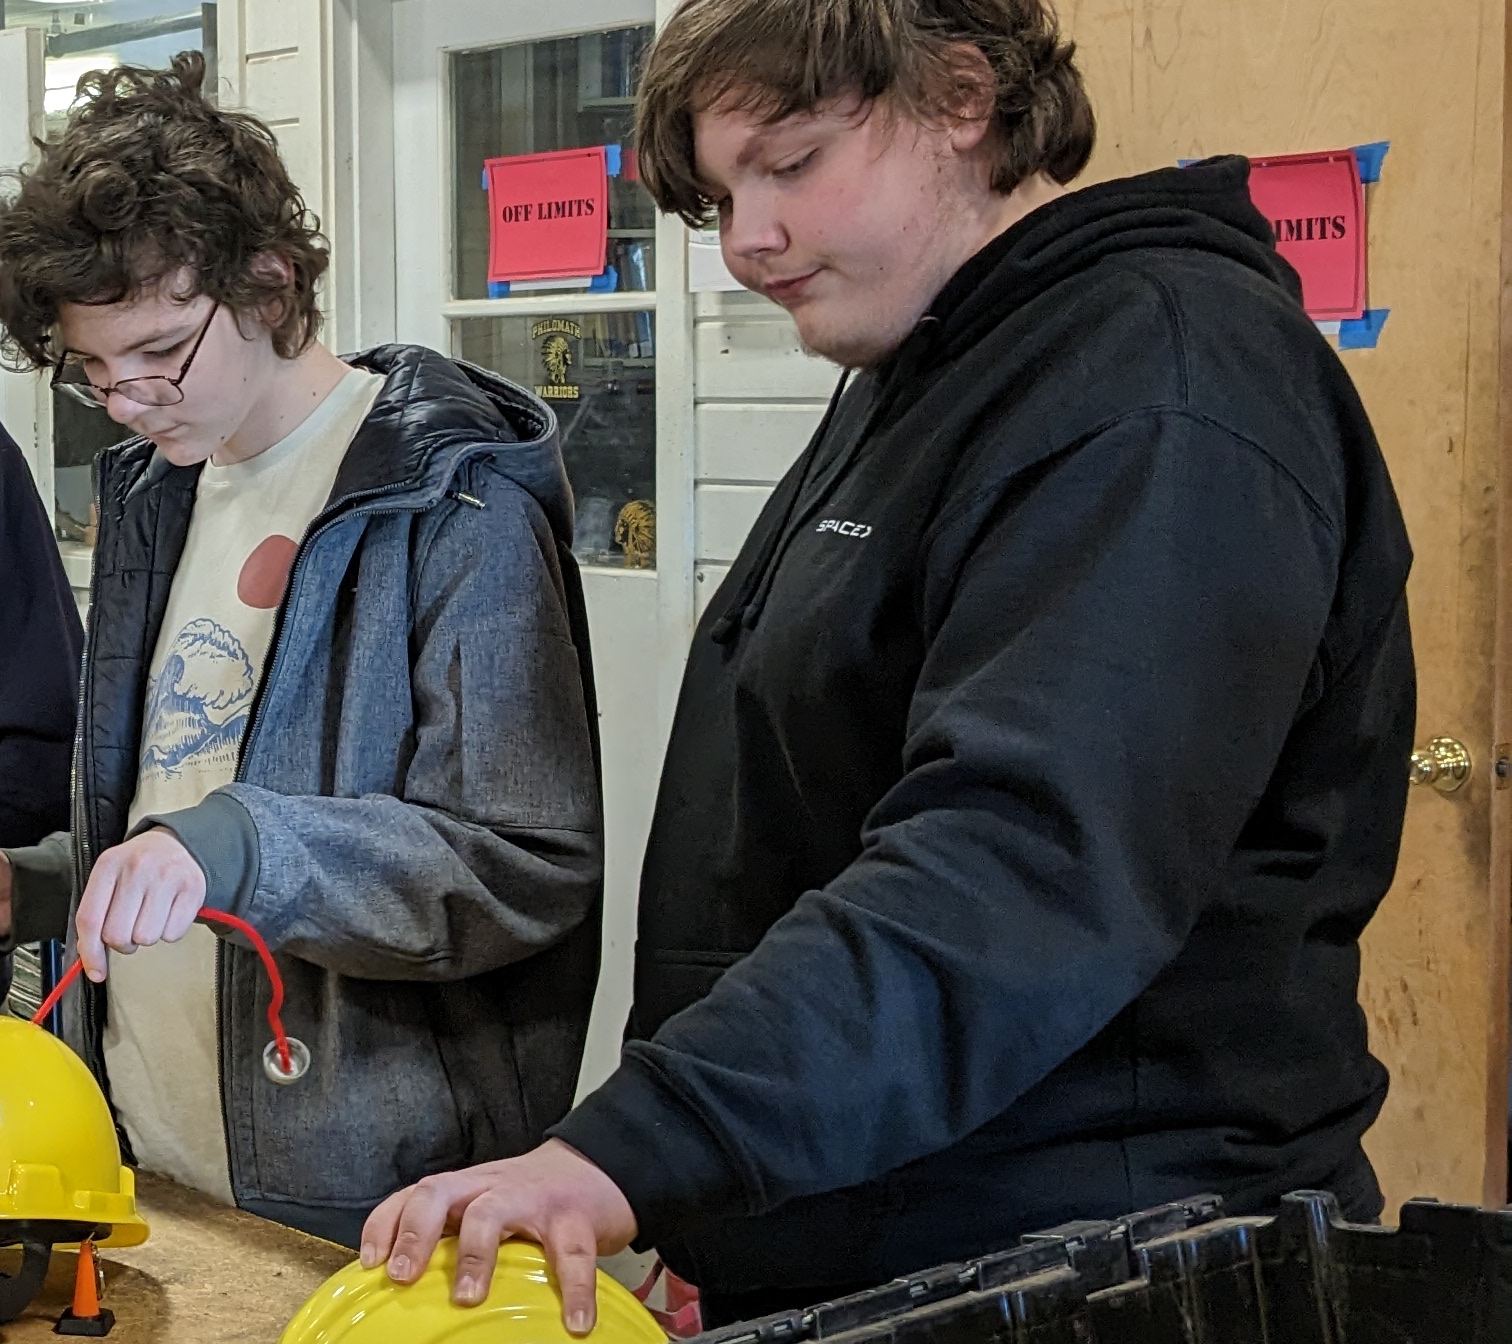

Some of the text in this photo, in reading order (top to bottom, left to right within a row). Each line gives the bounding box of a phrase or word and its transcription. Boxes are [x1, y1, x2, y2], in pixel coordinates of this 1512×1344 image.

[502, 198, 595, 224] OFF LIMITS
[1273, 215, 1347, 244] IMITS
[531, 319, 582, 340] PHILOMATH
[534, 386, 580, 399] WARRIORS
